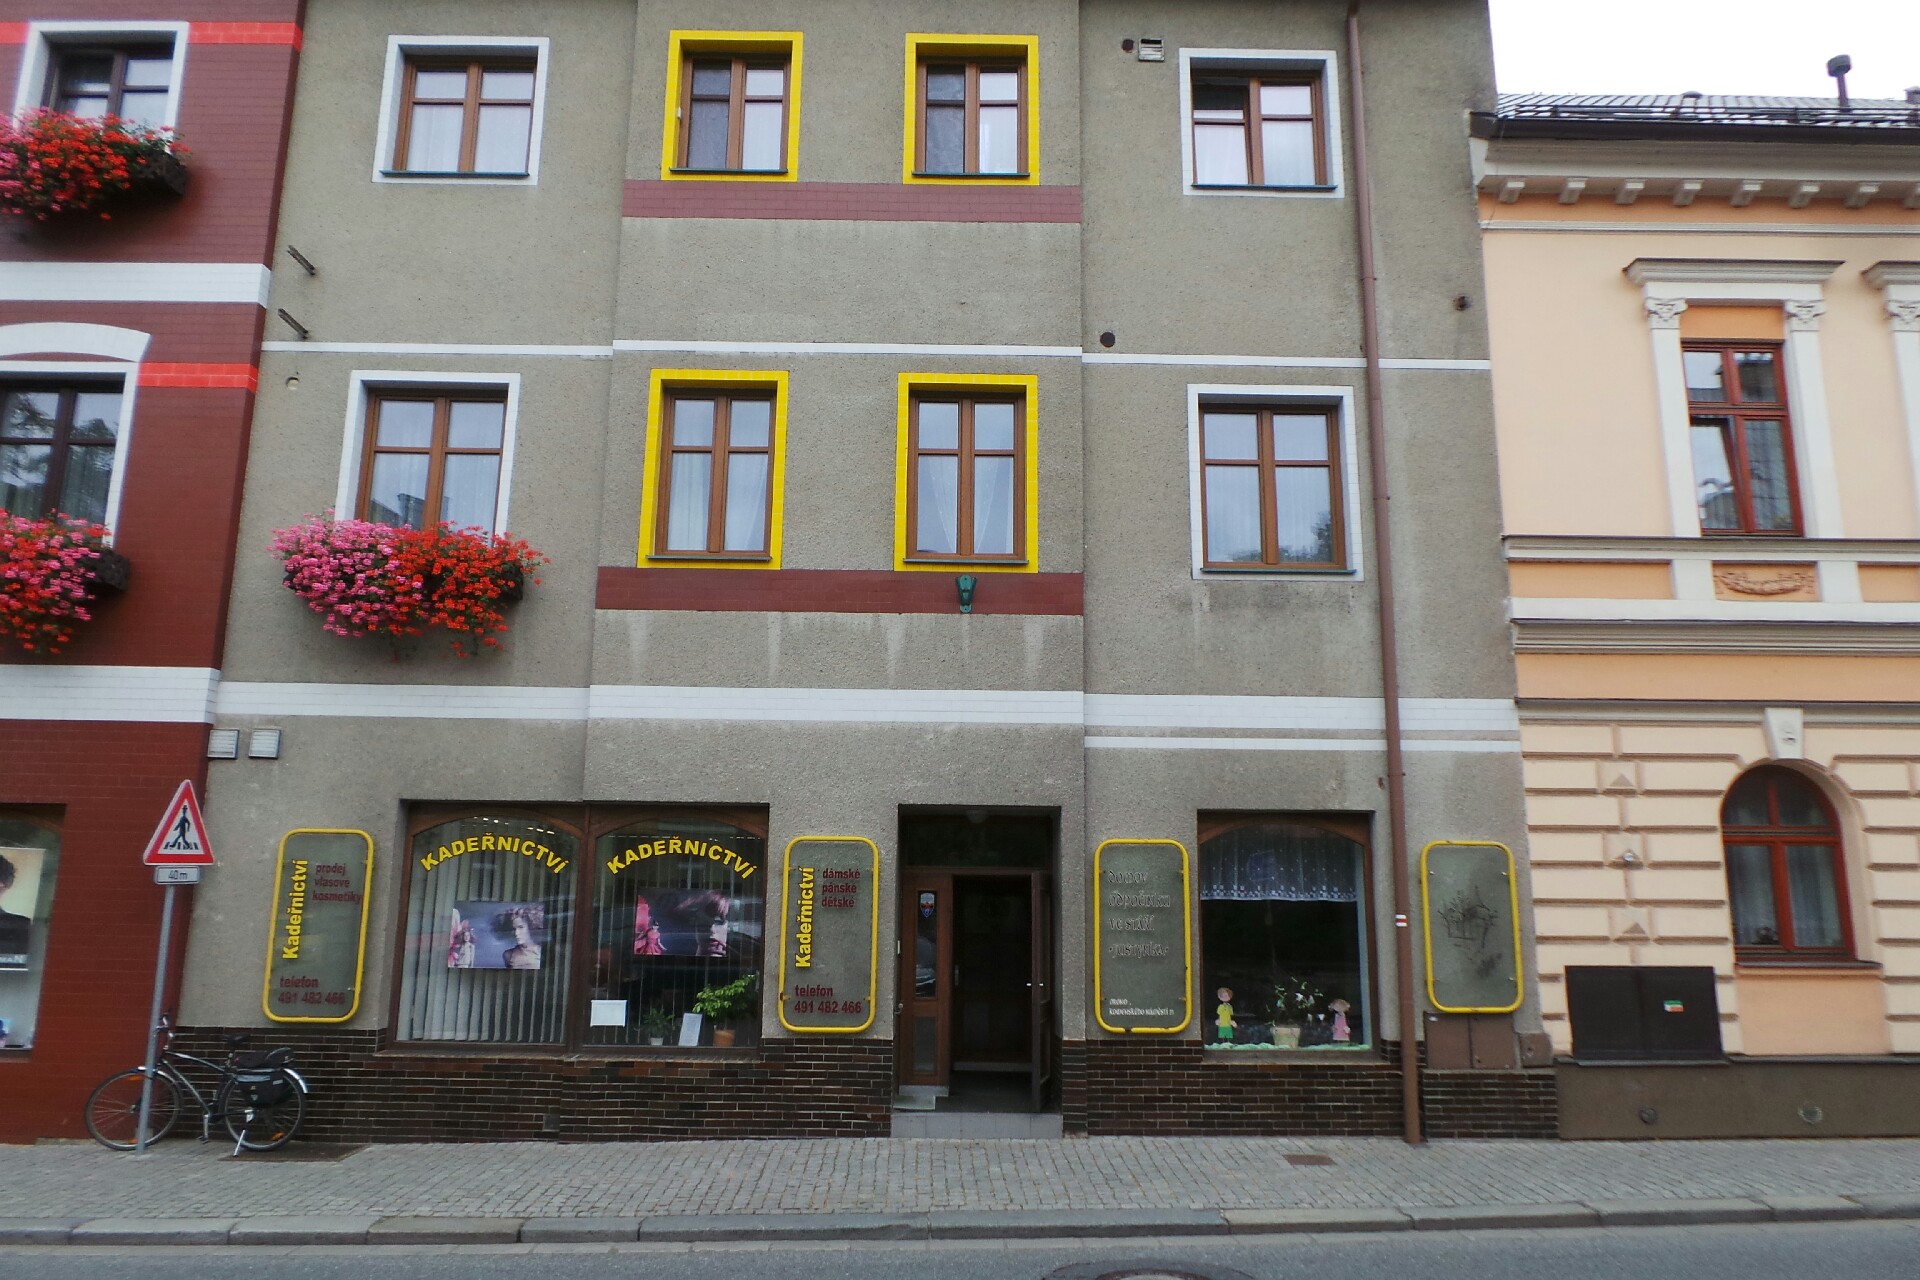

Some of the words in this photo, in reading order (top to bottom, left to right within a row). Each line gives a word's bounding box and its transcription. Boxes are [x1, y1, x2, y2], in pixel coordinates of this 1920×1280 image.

[420, 832, 569, 874] KADEŘNICTVÍ
[606, 835, 758, 879] KADEŘNICTVÍ
[316, 863, 346, 876] prodej
[822, 868, 861, 879] dámské
[822, 882, 857, 895] pánské
[312, 890, 361, 905] kosmetiky
[821, 896, 855, 907] dětské
[283, 859, 308, 959] Kadeřnictví
[795, 866, 814, 968] Kadeřnictví
[279, 975, 319, 988] telefon
[795, 984, 833, 997] telefon
[278, 991, 298, 1004] 491
[301, 991, 322, 1004] 482
[794, 1001, 814, 1013] 491
[817, 1001, 838, 1013] 482
[841, 1001, 862, 1014] 466
